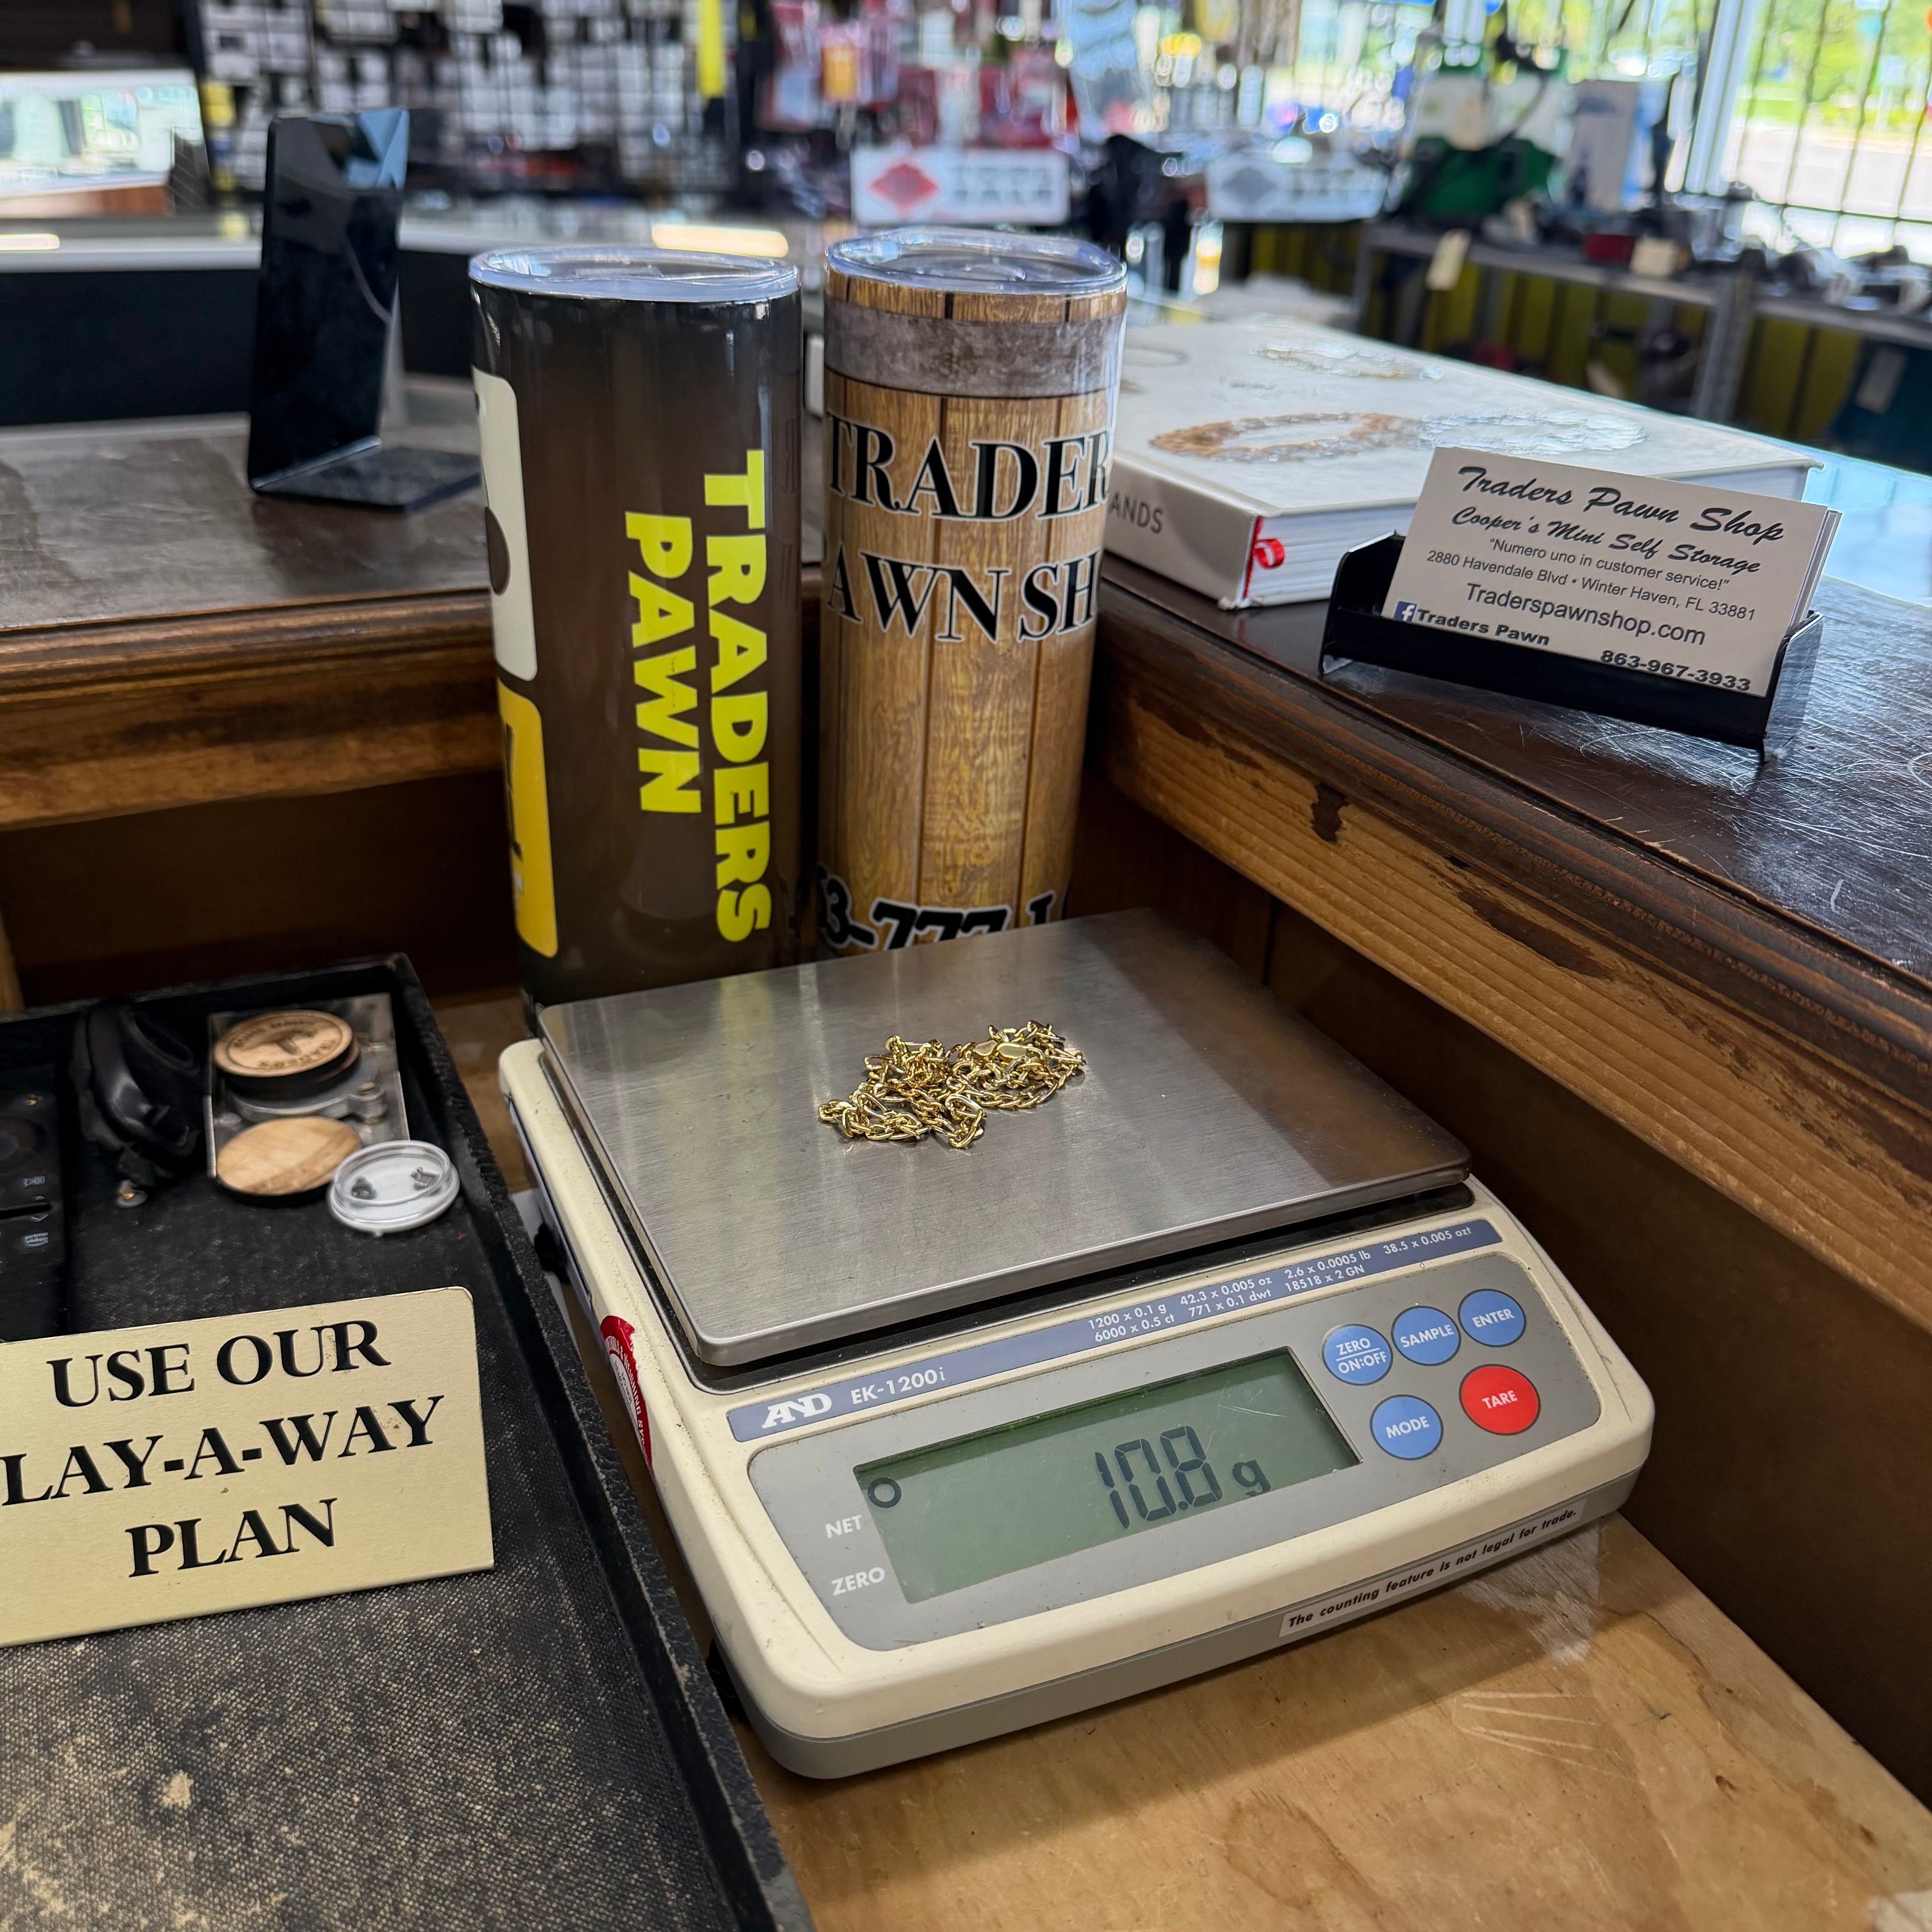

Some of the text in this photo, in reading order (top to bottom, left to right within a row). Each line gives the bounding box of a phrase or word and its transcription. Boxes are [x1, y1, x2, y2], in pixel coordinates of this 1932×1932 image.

[1458, 466, 1784, 545] Traders Pawn Shop
[1452, 507, 1760, 575] Cooper's Mini Self Storage
[1550, 552, 1576, 564] uno
[1579, 554, 1592, 567] in
[1596, 558, 1663, 579] customer
[825, 542, 1100, 642] AWN SH
[1426, 550, 1755, 621] 2880 Havendale Blvd Winter Haven, FL 33881
[1417, 609, 1489, 633] Traders
[1495, 624, 1550, 646] Pawn
[1466, 583, 1705, 646] Traderspawnshop.com
[625, 511, 701, 814] PAWN
[1600, 650, 1751, 691] 863-967-3933
[704, 450, 771, 942] TRADERS
[1383, 1226, 1471, 1254] 38.5 x 0.005 ozt
[1284, 1250, 1371, 1279] 2.6 x 0.0005 lb
[1285, 1264, 1365, 1292] 18518 x 2 GN
[1180, 1276, 1272, 1306] 42.3 x 0.005 oz
[1188, 1289, 1272, 1317] 771 x 0.1 dwt
[1088, 1304, 1167, 1330] 1200 x 0.1 g
[1095, 1314, 1175, 1342] 6000 x 0.5 ct
[1472, 1308, 1514, 1328] ENTER
[1336, 1337, 1371, 1355] ZERO
[1400, 1324, 1455, 1348] SAMPLE
[47, 1320, 391, 1407] USE OUR
[1338, 1351, 1387, 1374] ON:OFF
[850, 1366, 946, 1405] EK-1200i
[1482, 1390, 1518, 1410] TARE
[1386, 1416, 1430, 1439] MODE
[1, 1395, 445, 1506] LAY-A-WAY
[1095, 1425, 1271, 1529] 10.8 g
[125, 1498, 338, 1578] PLAN
[826, 1514, 862, 1538] NET
[831, 1566, 886, 1596] ZERO
[1289, 1510, 1576, 1627] The counting feature is not legal for trade.
